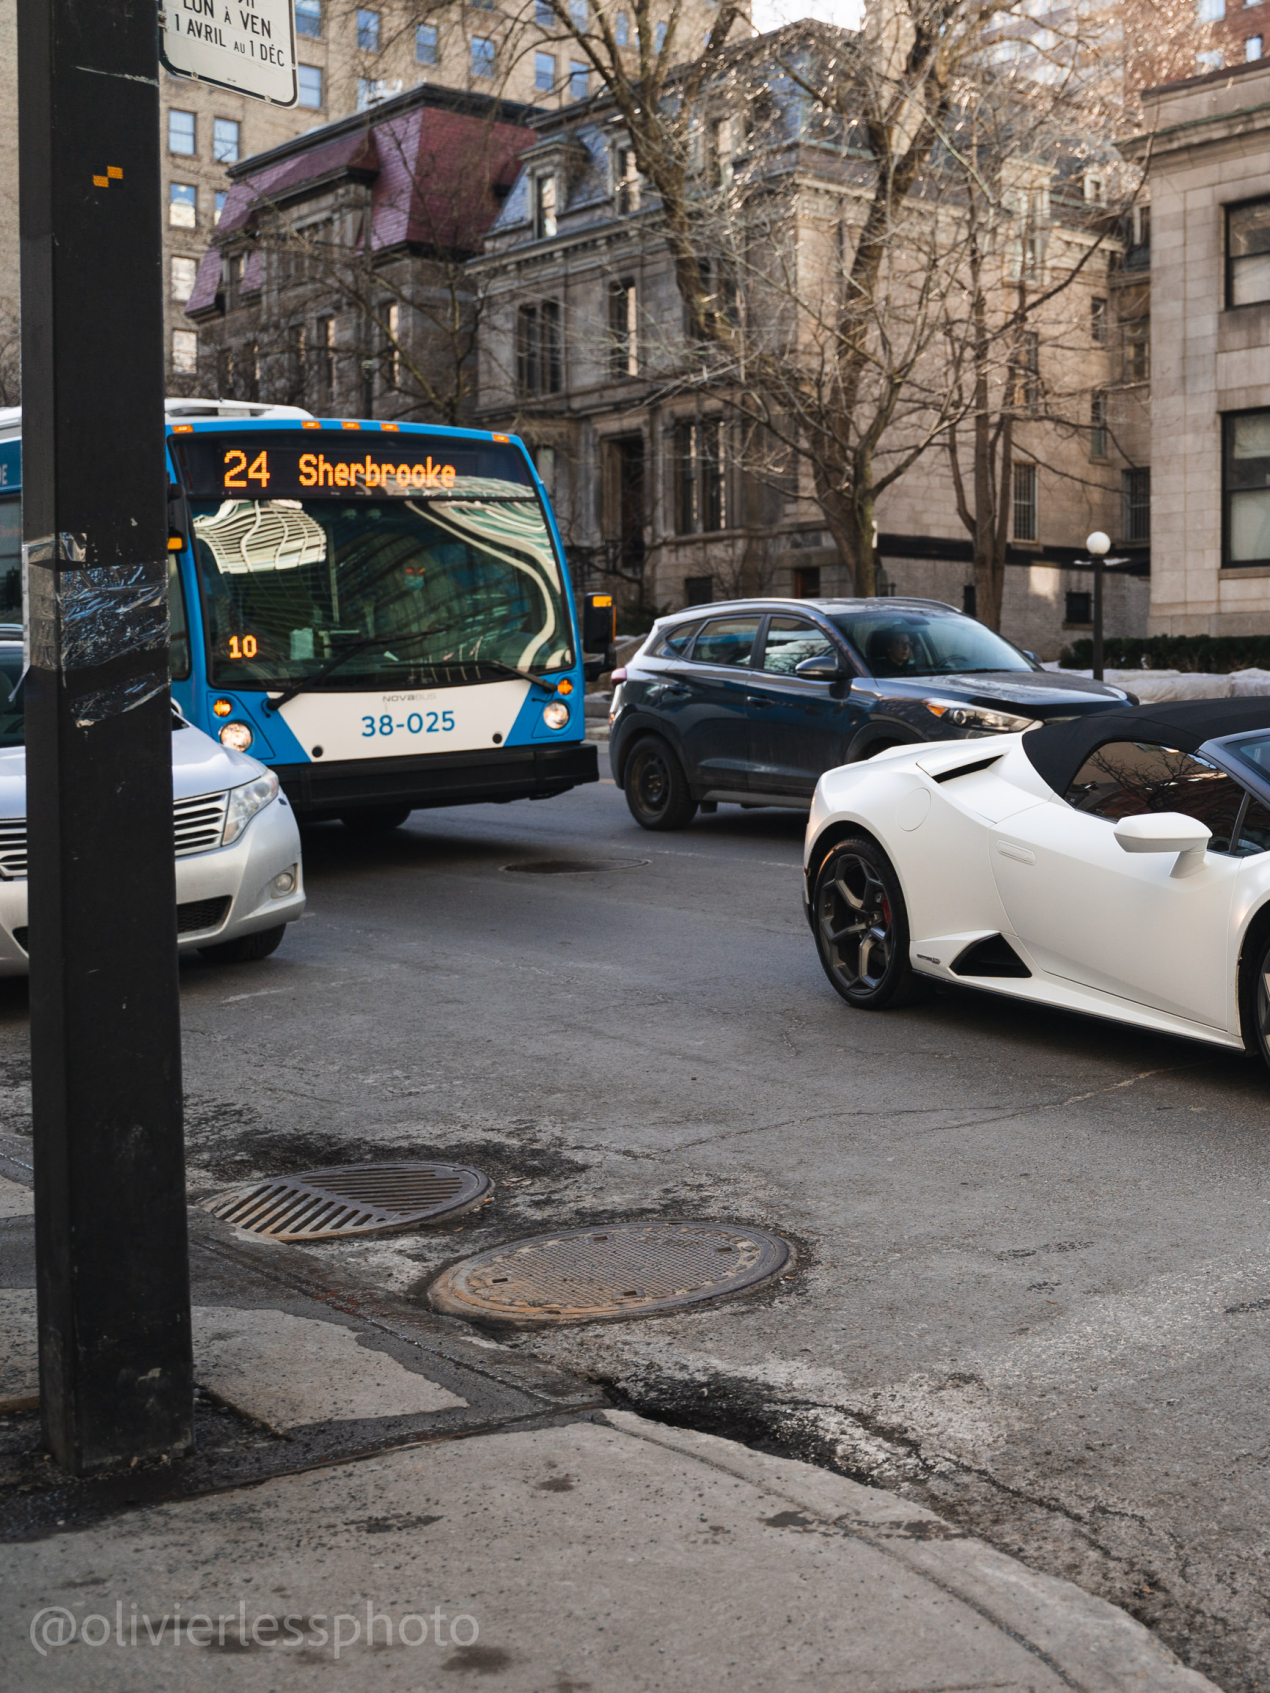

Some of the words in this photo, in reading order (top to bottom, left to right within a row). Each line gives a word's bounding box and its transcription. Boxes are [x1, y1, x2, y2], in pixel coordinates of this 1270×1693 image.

[224, 6, 232, 25] À
[240, 10, 271, 39] VEN
[175, 14, 180, 31] 1
[187, 18, 226, 47] AVRIL
[234, 41, 245, 54] AU
[250, 40, 254, 57] 1
[260, 43, 285, 67] DÉC
[224, 450, 270, 487] 24
[299, 454, 456, 487] Sherbrooke
[229, 635, 257, 658] 10
[362, 710, 455, 737] 38-025
